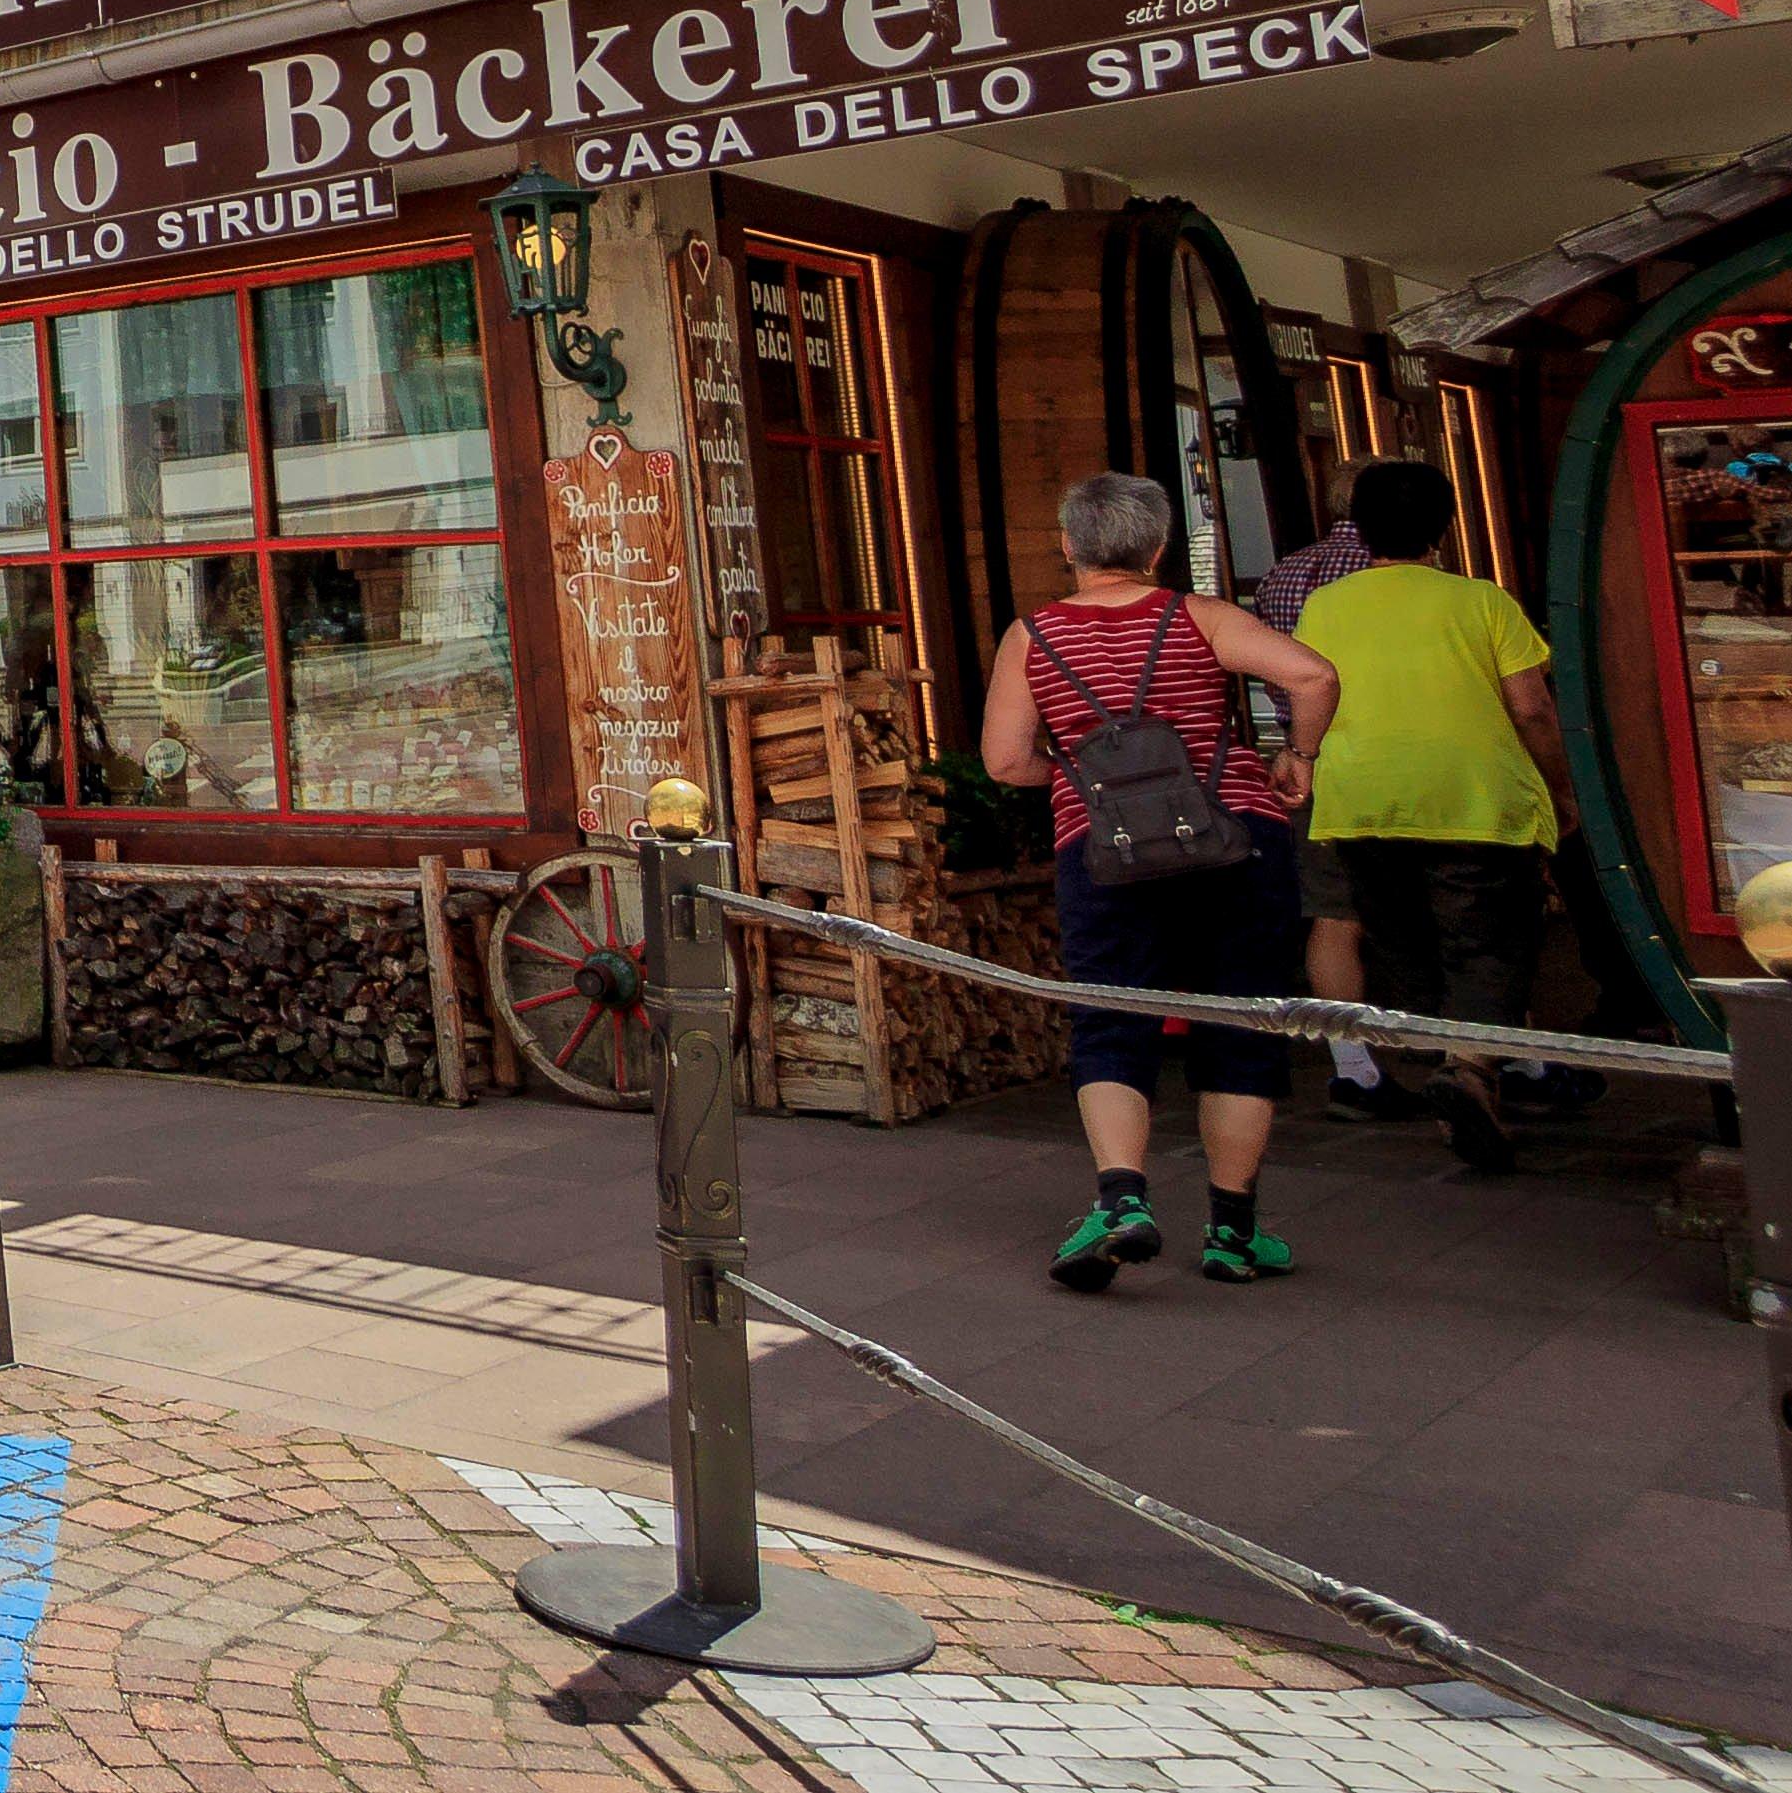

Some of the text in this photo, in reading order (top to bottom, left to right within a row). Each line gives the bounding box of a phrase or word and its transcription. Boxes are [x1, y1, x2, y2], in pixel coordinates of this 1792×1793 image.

[1125, 0, 1165, 25] seit
[574, 4, 1368, 182] CASA DELLO SPECK
[156, 176, 394, 250] STRUDEL
[683, 294, 733, 363] funghi
[695, 358, 743, 419] polenta
[700, 417, 744, 465] miele
[559, 481, 660, 529] Panificio
[578, 531, 652, 576] Hofer
[719, 542, 760, 610] pasta
[573, 593, 670, 641] Visitate
[617, 645, 637, 672] il
[598, 675, 670, 703] nostro
[596, 738, 684, 776] tirolese
[598, 713, 680, 753] negozio
